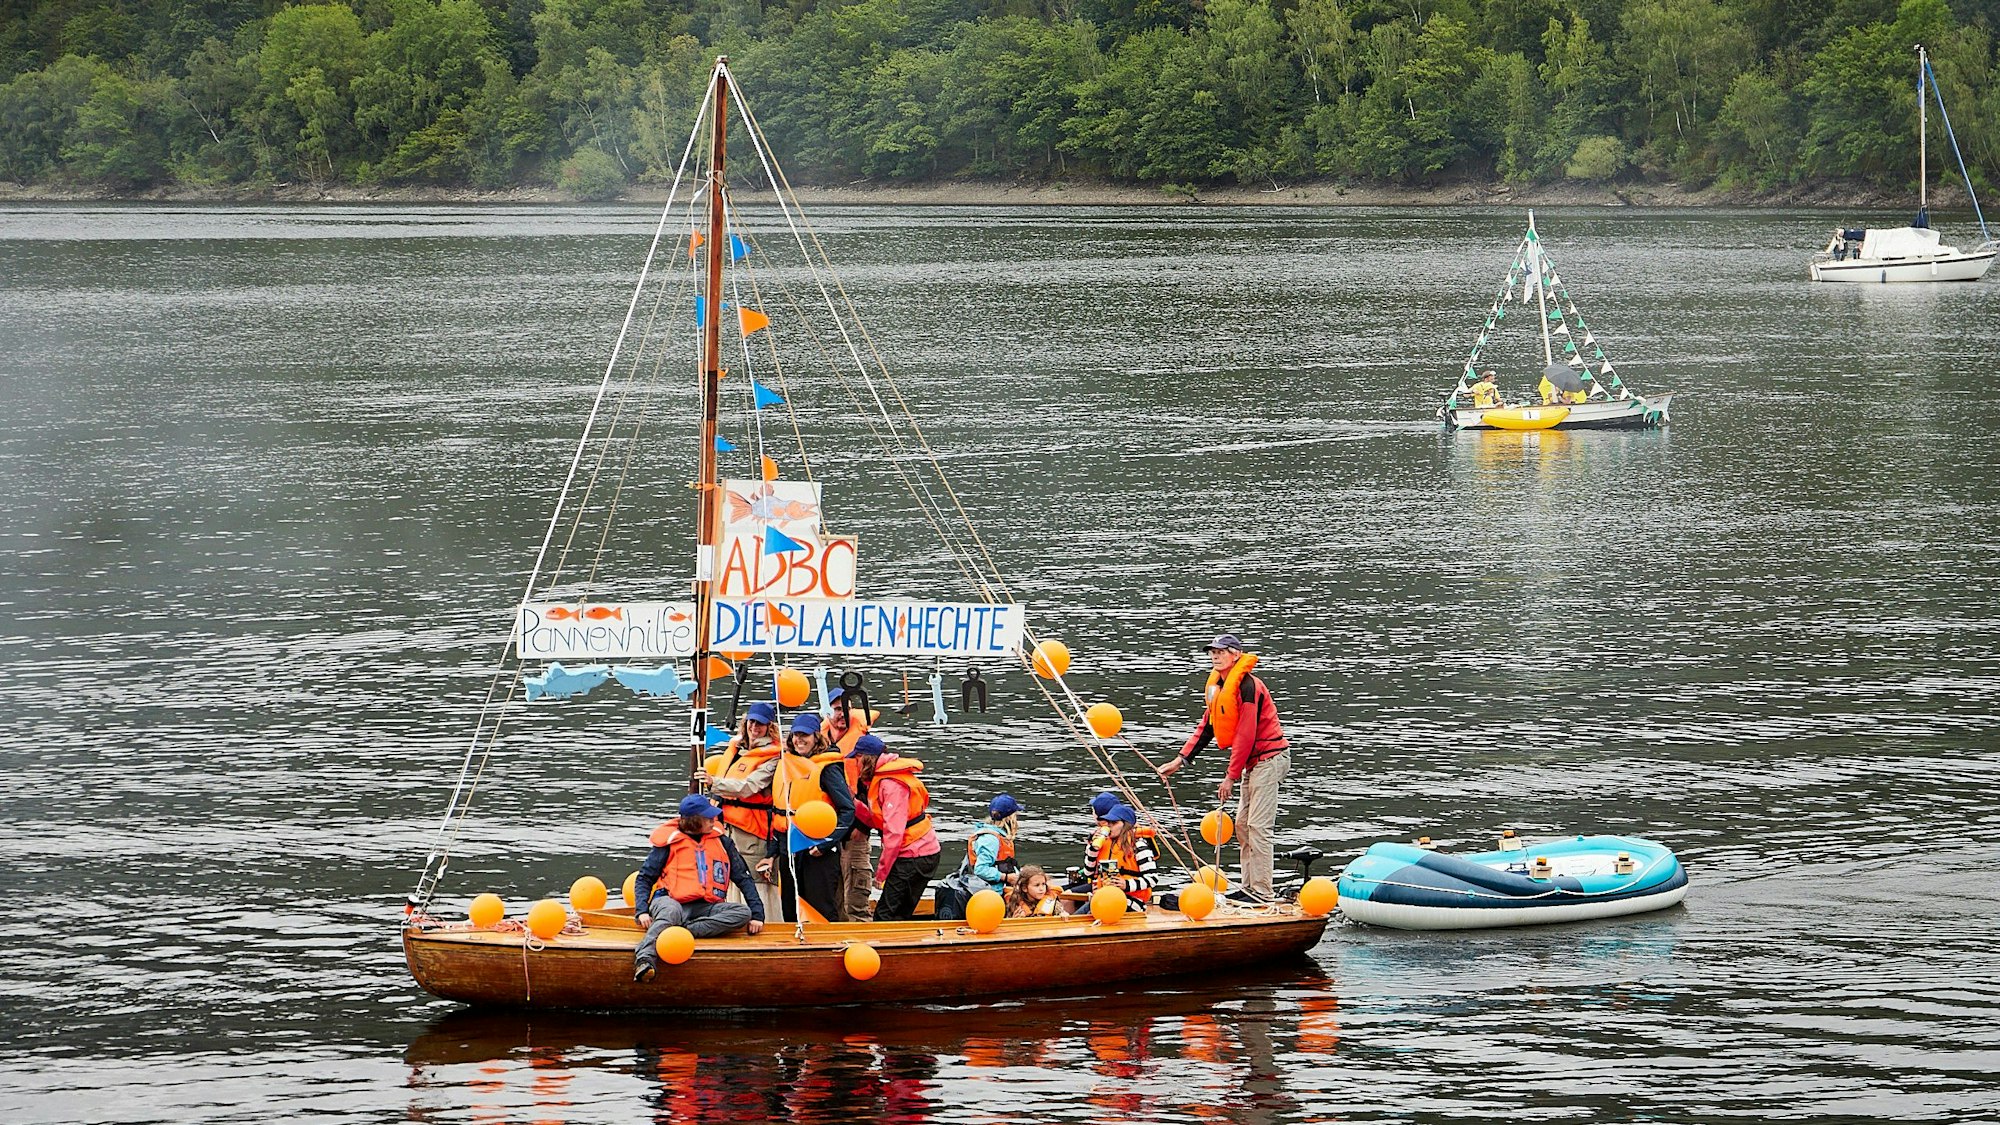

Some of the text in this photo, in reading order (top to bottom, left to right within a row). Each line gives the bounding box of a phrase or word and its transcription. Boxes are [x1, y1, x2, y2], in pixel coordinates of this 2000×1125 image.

[719, 536, 855, 598] ADBC
[521, 606, 691, 654] Pannenhilfe
[712, 601, 1009, 651] DIE BLAUEN HECHTE
[692, 711, 706, 741] 4
